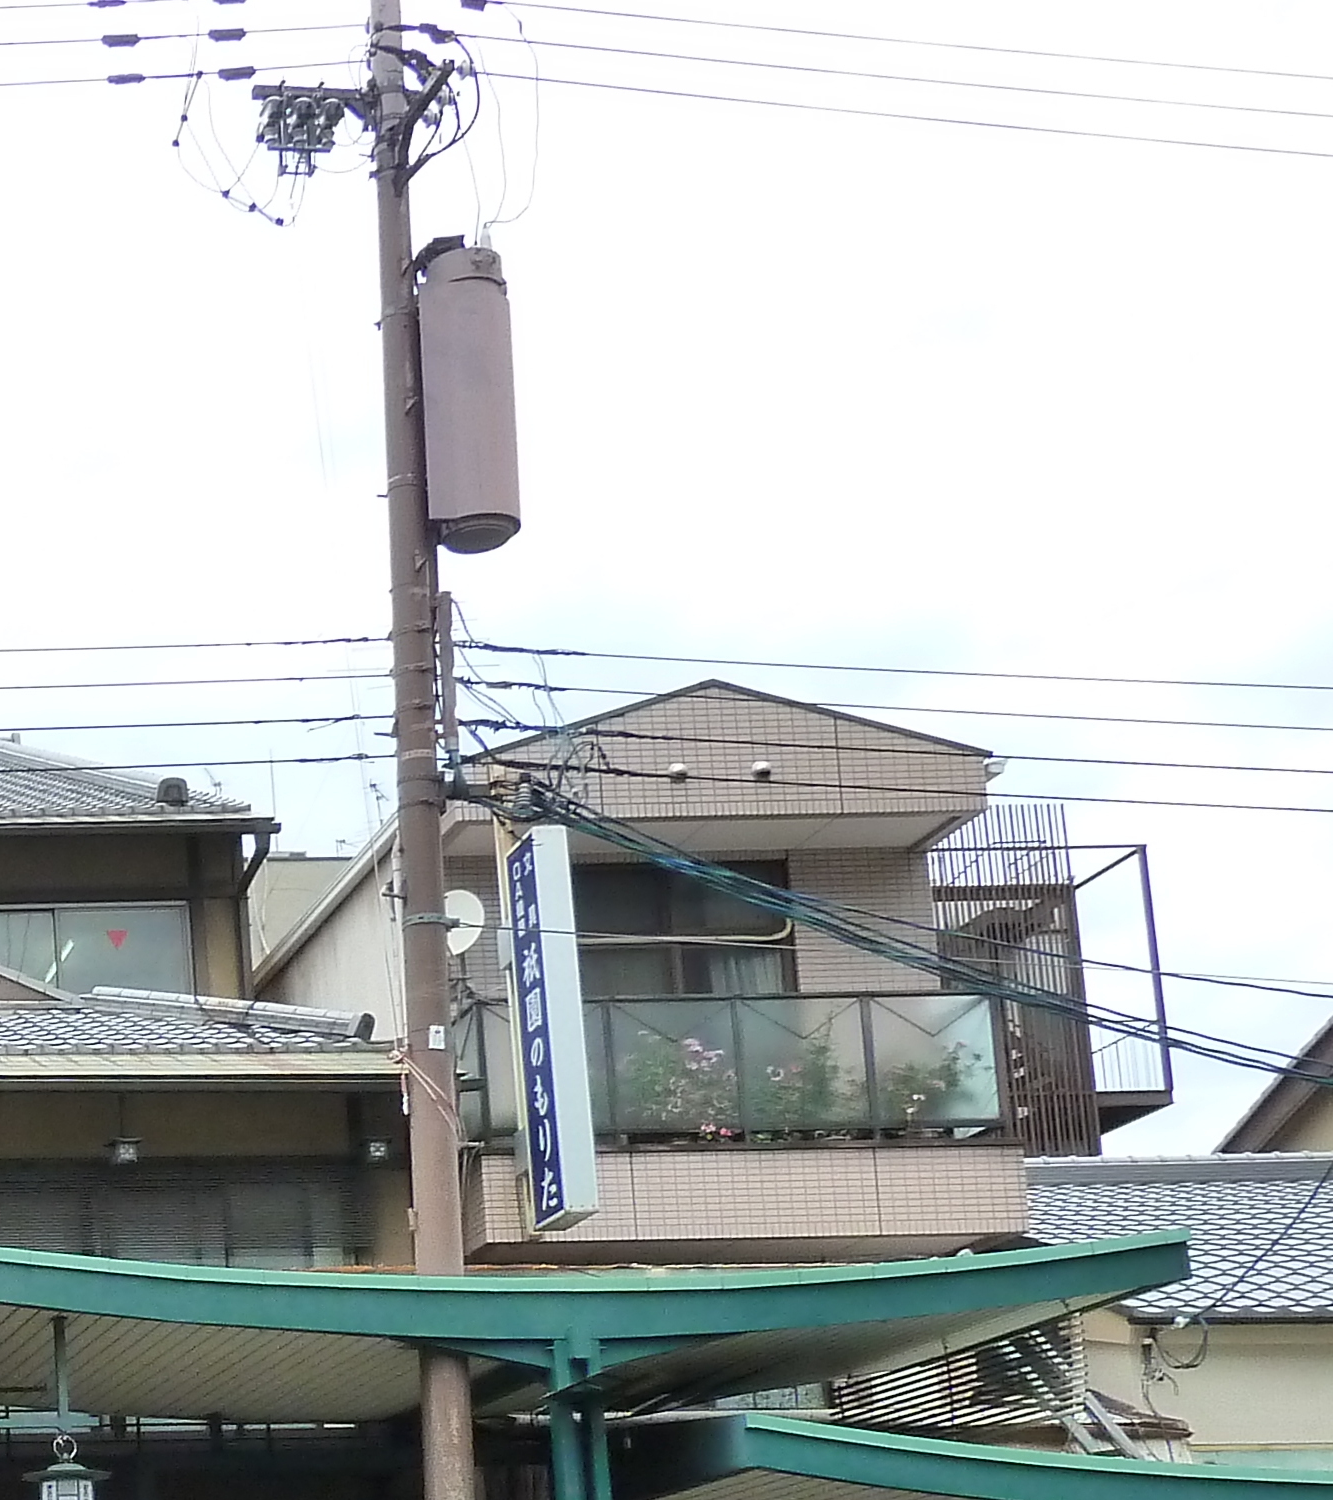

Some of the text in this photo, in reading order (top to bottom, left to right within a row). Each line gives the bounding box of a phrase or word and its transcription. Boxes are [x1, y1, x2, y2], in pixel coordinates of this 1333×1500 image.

[521, 942, 559, 1211] 祇園のもりた
